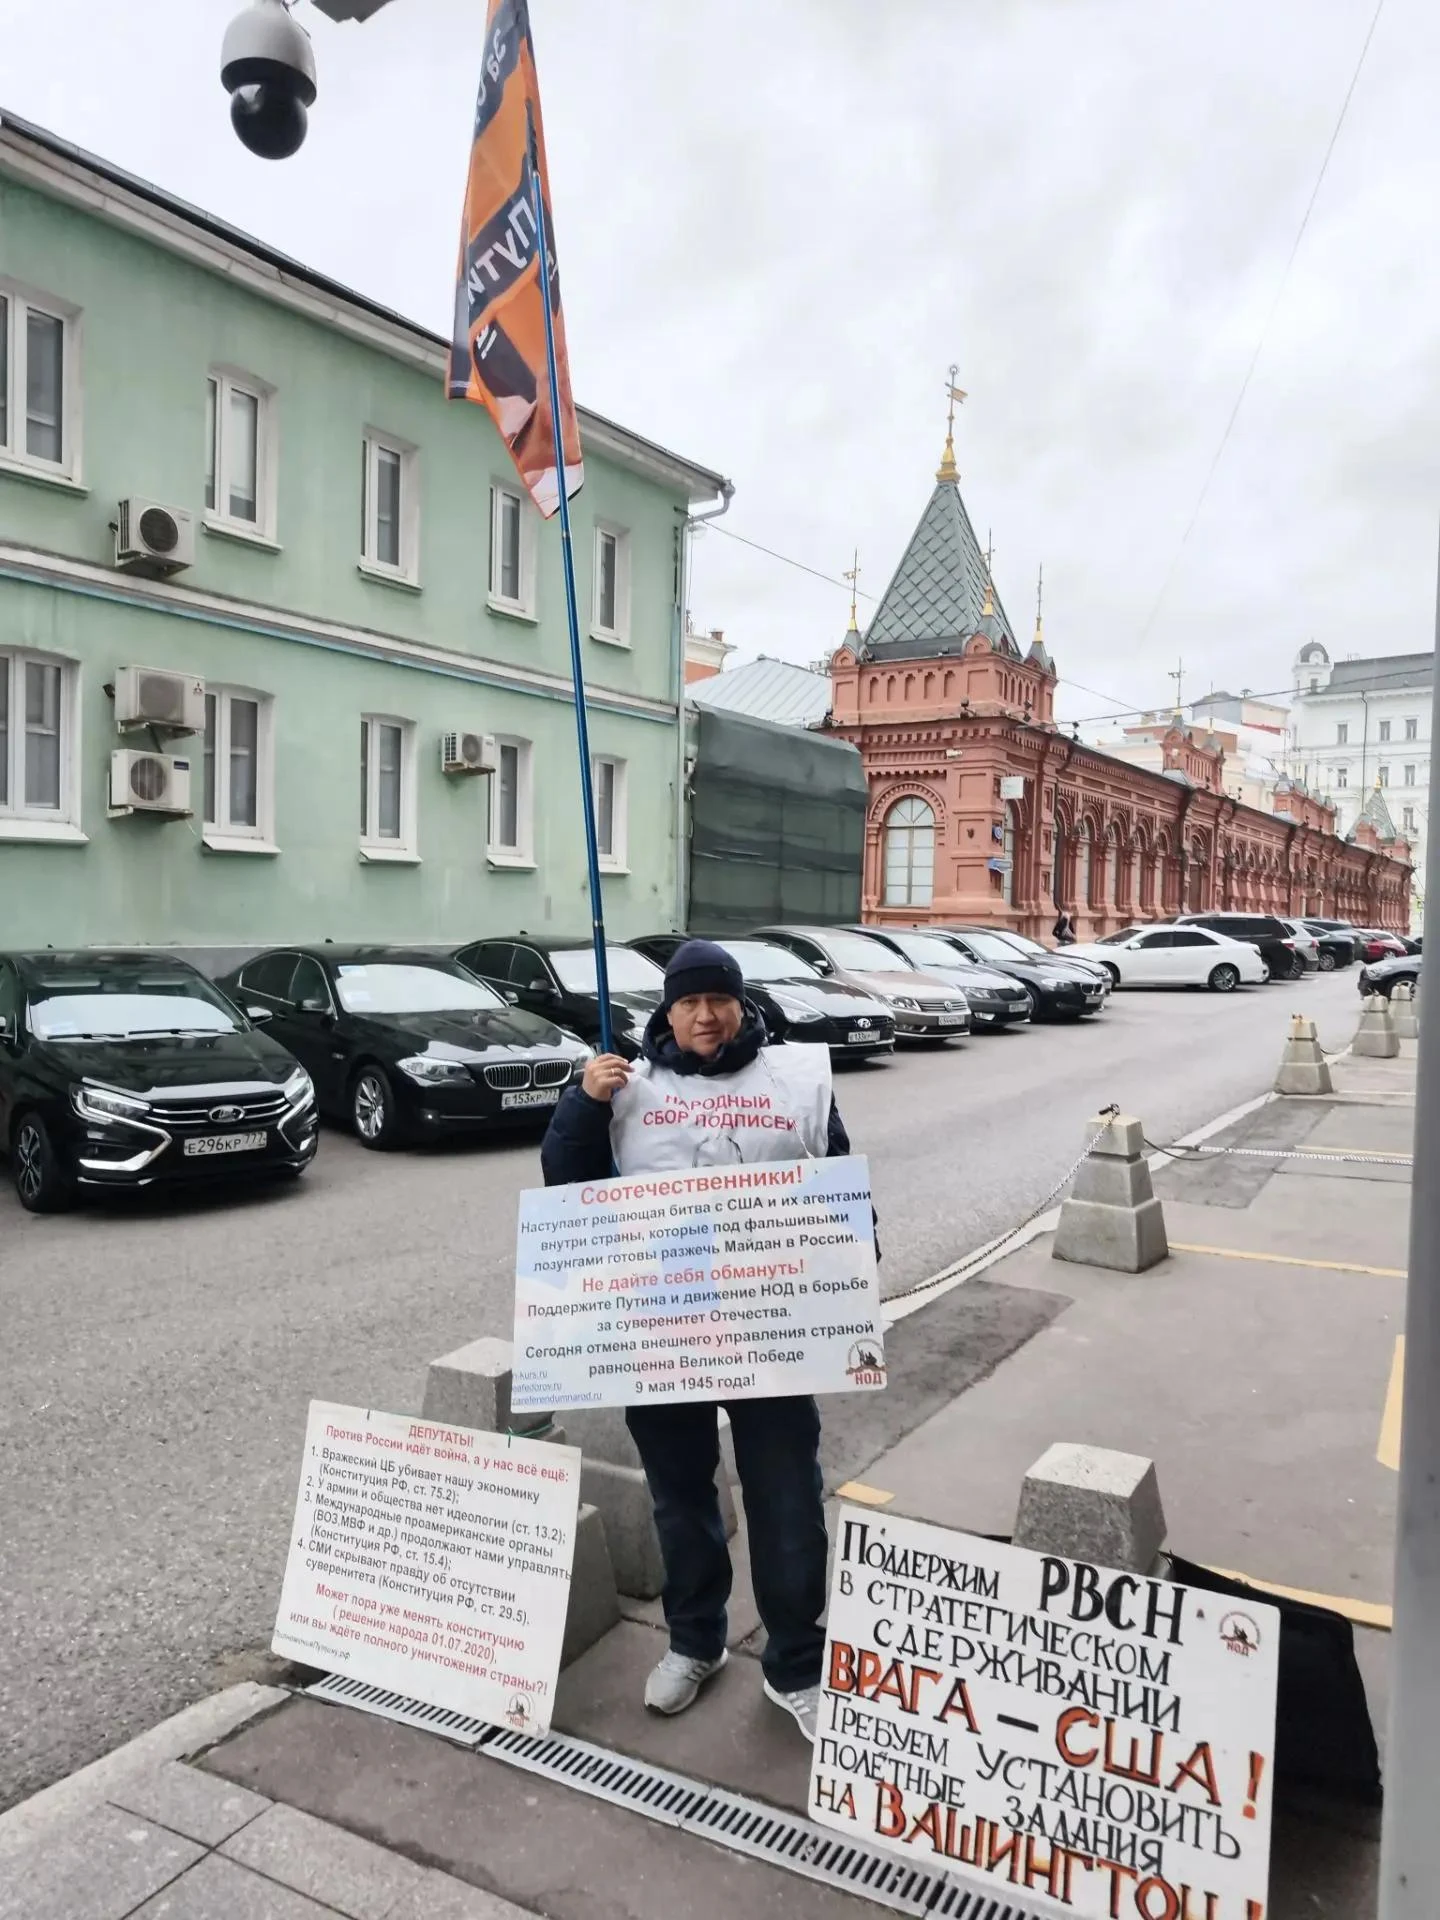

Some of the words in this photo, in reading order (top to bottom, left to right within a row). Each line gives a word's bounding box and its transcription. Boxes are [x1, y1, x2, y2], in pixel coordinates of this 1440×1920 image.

[643, 1110, 689, 1125] СБОР
[581, 1165, 802, 1204] Соотечественники!
[521, 1217, 588, 1234] Наступает
[592, 1209, 665, 1227] решающая
[669, 1204, 710, 1216] битва
[714, 1202, 723, 1212] с
[727, 1196, 763, 1211] США
[768, 1198, 776, 1207] и
[781, 1196, 798, 1206] их
[803, 1190, 871, 1204] агентами
[541, 1238, 586, 1251] внутри
[591, 1232, 644, 1246] страны,
[649, 1224, 708, 1239] которые
[713, 1221, 740, 1233] под
[744, 1213, 849, 1232] фальшивыми
[534, 1256, 603, 1271] лозунгами
[608, 1250, 656, 1264] готовы
[661, 1245, 720, 1261] разжечь
[724, 1239, 781, 1252] Майдан
[786, 1238, 794, 1247] в
[799, 1233, 858, 1246] России.
[582, 1277, 603, 1292] Не
[608, 1273, 658, 1291] дайте
[664, 1268, 704, 1284] себя
[710, 1258, 804, 1280] обмануть!
[528, 1300, 611, 1317] Поддержите
[616, 1296, 666, 1310] Путина
[671, 1294, 678, 1303] и
[683, 1288, 756, 1304] движение
[760, 1282, 794, 1297] НОД
[799, 1284, 807, 1294] в
[812, 1277, 868, 1293] борьбе
[597, 1321, 611, 1331] за
[616, 1313, 705, 1332] суверенитет
[710, 1307, 791, 1322] Отечества.
[525, 1345, 582, 1358] Сегодня
[586, 1341, 636, 1353] отмена
[641, 1335, 711, 1349] внешнего
[716, 1328, 806, 1346] управления
[810, 1320, 874, 1338] страной
[589, 1360, 674, 1377] равноценна
[679, 1352, 742, 1368] Великой
[748, 1349, 804, 1363] Победе
[635, 1381, 643, 1393] 9
[648, 1381, 674, 1392] мая
[680, 1376, 713, 1390] 1945
[718, 1373, 755, 1389] года!
[855, 1372, 882, 1385] НОД
[326, 1425, 362, 1442] Против
[365, 1432, 402, 1450] России
[406, 1442, 431, 1455] идёт
[434, 1448, 470, 1463] война,
[473, 1456, 480, 1465] а
[483, 1457, 490, 1468] у
[493, 1459, 513, 1472] нас
[516, 1463, 537, 1476] всё
[312, 1445, 318, 1456] 1.
[321, 1447, 376, 1469] Вражеский
[380, 1458, 395, 1473] ЦБ
[397, 1464, 442, 1482] убивает
[444, 1474, 473, 1491] нашу
[477, 1481, 539, 1504] экономику
[319, 1463, 388, 1487] (Конституция
[413, 1485, 426, 1495] ст.
[430, 1485, 459, 1504] 75.2);
[304, 1490, 312, 1502] 3.
[315, 1493, 402, 1523] Международные
[404, 1515, 505, 1546] проамериканские
[508, 1539, 552, 1558] органы
[306, 1475, 314, 1487] 2.
[318, 1477, 324, 1488] У
[326, 1482, 358, 1496] армии
[361, 1490, 367, 1499] и
[370, 1491, 422, 1512] общества
[425, 1504, 444, 1515] нет
[446, 1508, 508, 1530] идеологии
[511, 1520, 530, 1535] (ст.
[535, 1525, 565, 1544] 13.2);
[297, 1537, 305, 1549] 4.
[308, 1540, 331, 1556] СМИ
[334, 1549, 387, 1569] скрывают
[389, 1562, 430, 1582] правду
[432, 1572, 446, 1584] об
[450, 1578, 515, 1602] отсутствии
[310, 1524, 380, 1551] (Конституция
[405, 1550, 418, 1561] ст.
[423, 1551, 451, 1571] 15.4);
[368, 1524, 374, 1533] и
[376, 1526, 397, 1541] др.)
[400, 1531, 472, 1556] продолжают
[474, 1548, 504, 1564] нами
[507, 1556, 570, 1579] управлять
[305, 1558, 375, 1584] суверенитета
[378, 1575, 453, 1604] (Конституция
[480, 1603, 494, 1616] ст.
[498, 1606, 529, 1626] 29.5).
[1037, 1557, 1187, 1646] РВСН
[316, 1583, 349, 1602] Может
[351, 1595, 376, 1610] пора
[379, 1603, 400, 1616] уже
[402, 1609, 443, 1628] менять
[446, 1621, 524, 1650] конституцию
[338, 1609, 386, 1630] решение
[388, 1622, 428, 1643] народа
[867, 1580, 1172, 1686] СТРАТЕГИЧЕСКОМ
[290, 1612, 309, 1625] или
[311, 1618, 327, 1630] вы
[329, 1623, 360, 1640] ждёте
[363, 1633, 408, 1654] полного
[410, 1647, 487, 1677] уничтожения
[490, 1670, 547, 1695] страны?!
[873, 1619, 1181, 1733] СДЕРЖИВАНИИ
[828, 1640, 981, 1735] ВРАГА
[815, 1775, 857, 1820] НА
[820, 1737, 966, 1808] ПОЛЁТНЫЕ
[1003, 1796, 1164, 1876] ЗАДАНИЯ
[976, 1742, 1241, 1859] УСТАНОВИТЬ
